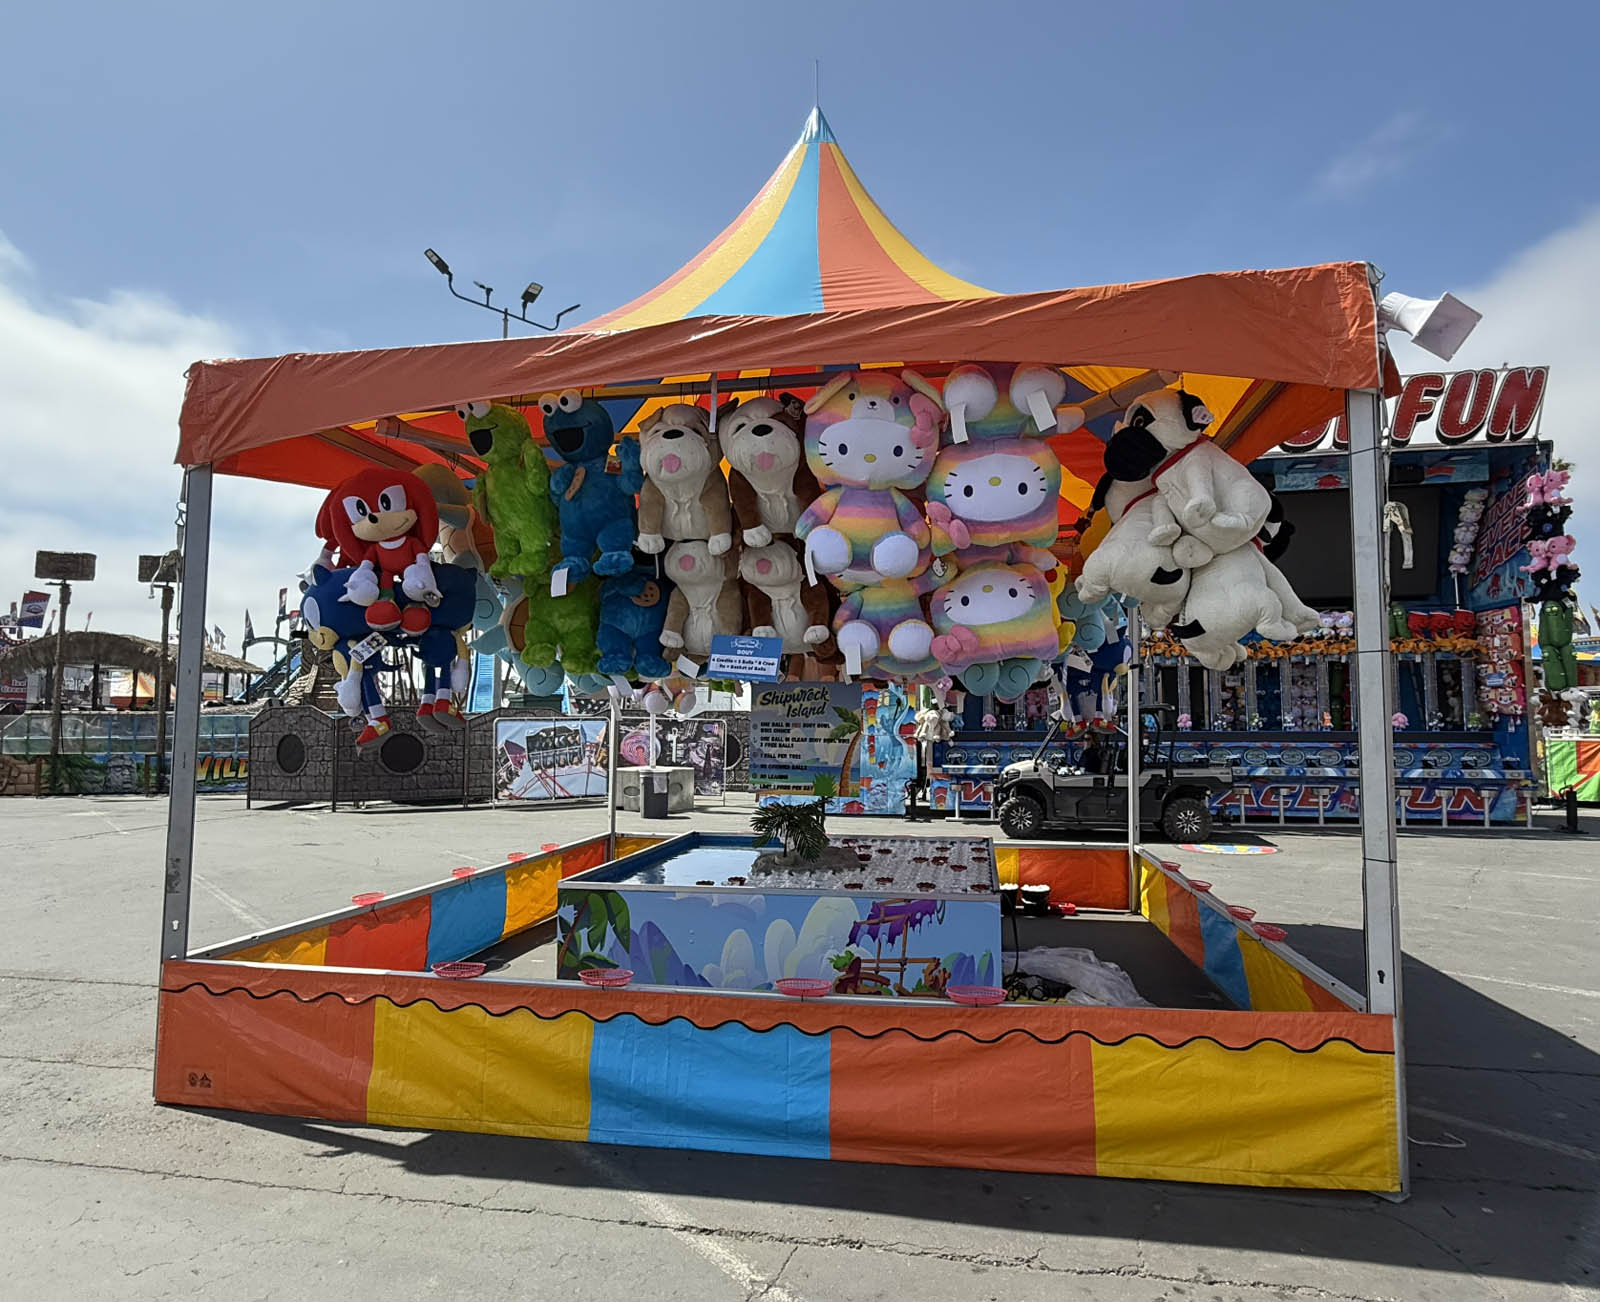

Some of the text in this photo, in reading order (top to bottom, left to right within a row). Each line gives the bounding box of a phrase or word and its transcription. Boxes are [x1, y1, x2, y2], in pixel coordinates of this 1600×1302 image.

[1390, 367, 1549, 447] FUN
[760, 686, 830, 706] Shipwreck
[786, 702, 826, 718] Island
